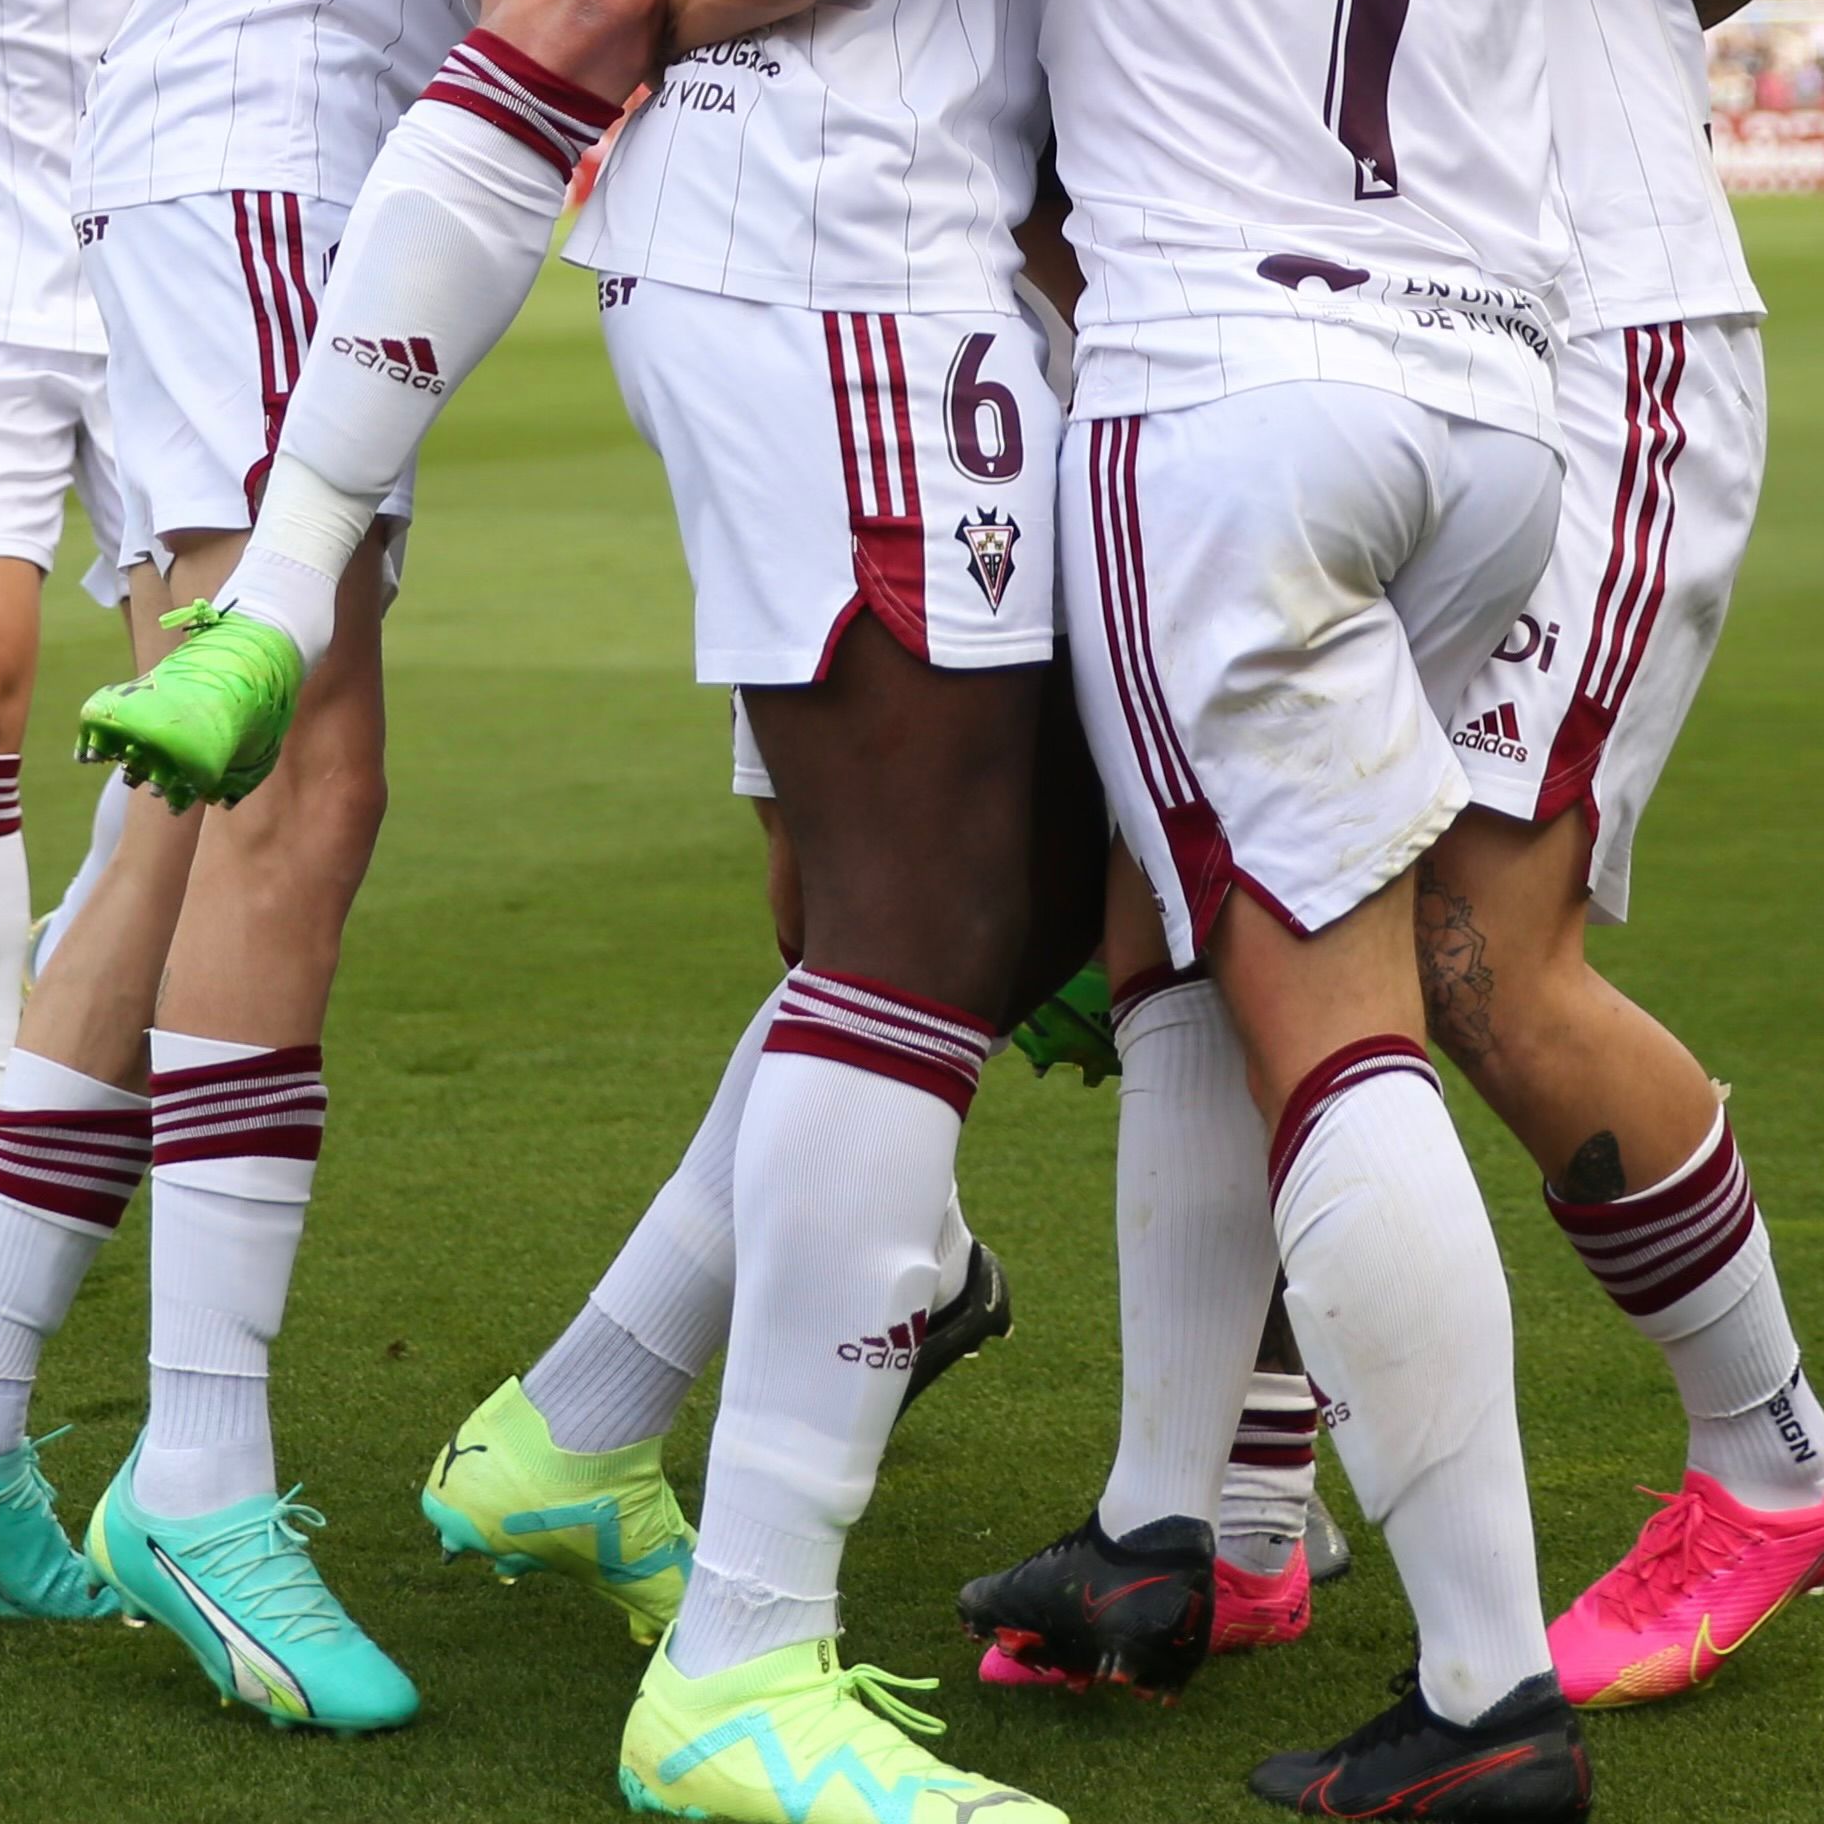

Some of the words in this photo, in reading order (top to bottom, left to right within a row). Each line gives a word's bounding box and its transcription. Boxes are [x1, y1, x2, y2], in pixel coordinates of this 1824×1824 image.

[680, 80, 736, 114] VIDA
[1411, 308, 1454, 331] DE
[1461, 309, 1495, 335] TU
[331, 336, 445, 395] adidas
[943, 332, 1025, 485] 6
[1452, 727, 1528, 764] adidas
[837, 1342, 917, 1370] adid
[1769, 1386, 1817, 1464] SIGN
